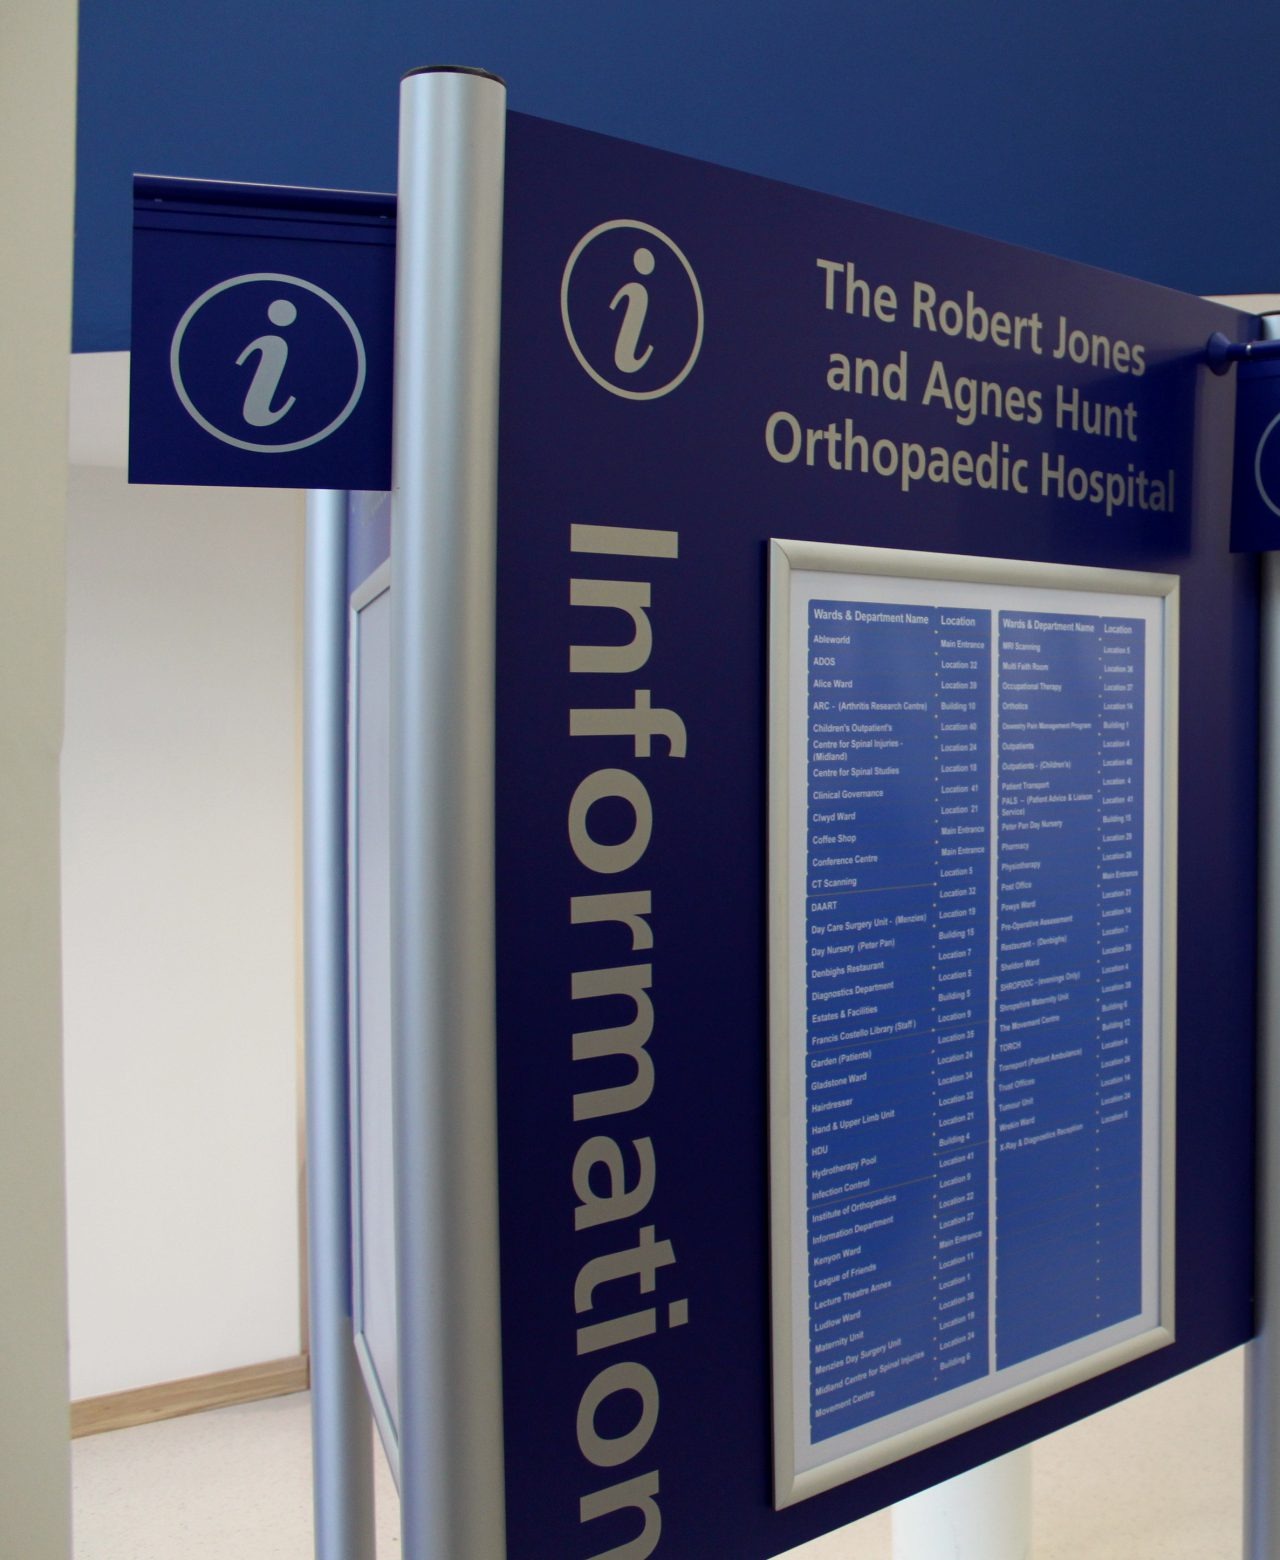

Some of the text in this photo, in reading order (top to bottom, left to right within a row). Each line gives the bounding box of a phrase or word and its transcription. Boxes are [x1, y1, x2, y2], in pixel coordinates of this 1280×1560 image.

[816, 258, 1146, 377] The Robert Jones
[826, 350, 1137, 442] and Agnes Hunt
[764, 411, 1175, 517] Orthopaedic Hospital
[814, 609, 929, 624] Wards & Department Name
[941, 616, 975, 627] Location
[1003, 619, 1094, 632] Wards & Department Name
[1104, 624, 1132, 634] Location
[813, 635, 850, 644] Ableworld
[813, 657, 835, 666] ADOS
[941, 661, 968, 669] Location
[813, 679, 852, 688] Alice Ward
[813, 702, 927, 712] ARC (Arthritis Research Centre)
[813, 723, 892, 733] Children's Outpatient's
[813, 739, 898, 749] Centre for Spinal Injuries
[813, 752, 847, 761] (Midland)
[813, 766, 899, 777] Centre for Spinal Studies
[813, 790, 884, 800] Clinical Governance
[813, 812, 856, 823] Clwyd Ward
[812, 834, 856, 844] Coffee Shop
[812, 854, 878, 867] Conference Centre
[812, 878, 856, 888] CT Scanning
[812, 902, 837, 912] DAART
[812, 925, 825, 935] Day
[827, 923, 843, 933] Care
[845, 920, 872, 931] Surgery
[874, 918, 888, 927] Unit
[812, 939, 895, 958] Day Nursery (Peter Pan)
[812, 961, 884, 978] Denbighs Restaurant
[812, 981, 894, 1001] Diagnostics Department
[812, 1006, 878, 1023] Estates & Facilities
[568, 523, 688, 1560] Information
[812, 1035, 838, 1046] Francis
[840, 1029, 868, 1041] Costello
[870, 1025, 893, 1036] Library
[811, 1050, 872, 1068] Garden (Patients)
[811, 1072, 867, 1091] Gladstone Ward
[812, 1099, 852, 1113] Hairdresser
[812, 1110, 895, 1135] Hand & Upper Limb Unit
[812, 1145, 828, 1156] HDU
[812, 1156, 876, 1179] Hydrotherapy Pool
[812, 1178, 870, 1200] Infection Control
[812, 1194, 896, 1223] Institute of Orthopaedics
[812, 1215, 894, 1245] Information Department
[814, 1246, 861, 1266] Kenyon Ward
[814, 1263, 876, 1289] League of Friends
[814, 1280, 891, 1310] Lecture Theatre Annex
[814, 1310, 861, 1332] Ludlow Ward
[815, 1331, 864, 1354] Maternity Unit
[815, 1338, 902, 1375] Menzies Day Surgery Unit
[815, 1351, 925, 1396] Midland Centre for Spinal Injuries
[815, 1389, 876, 1418] Movement Centre
